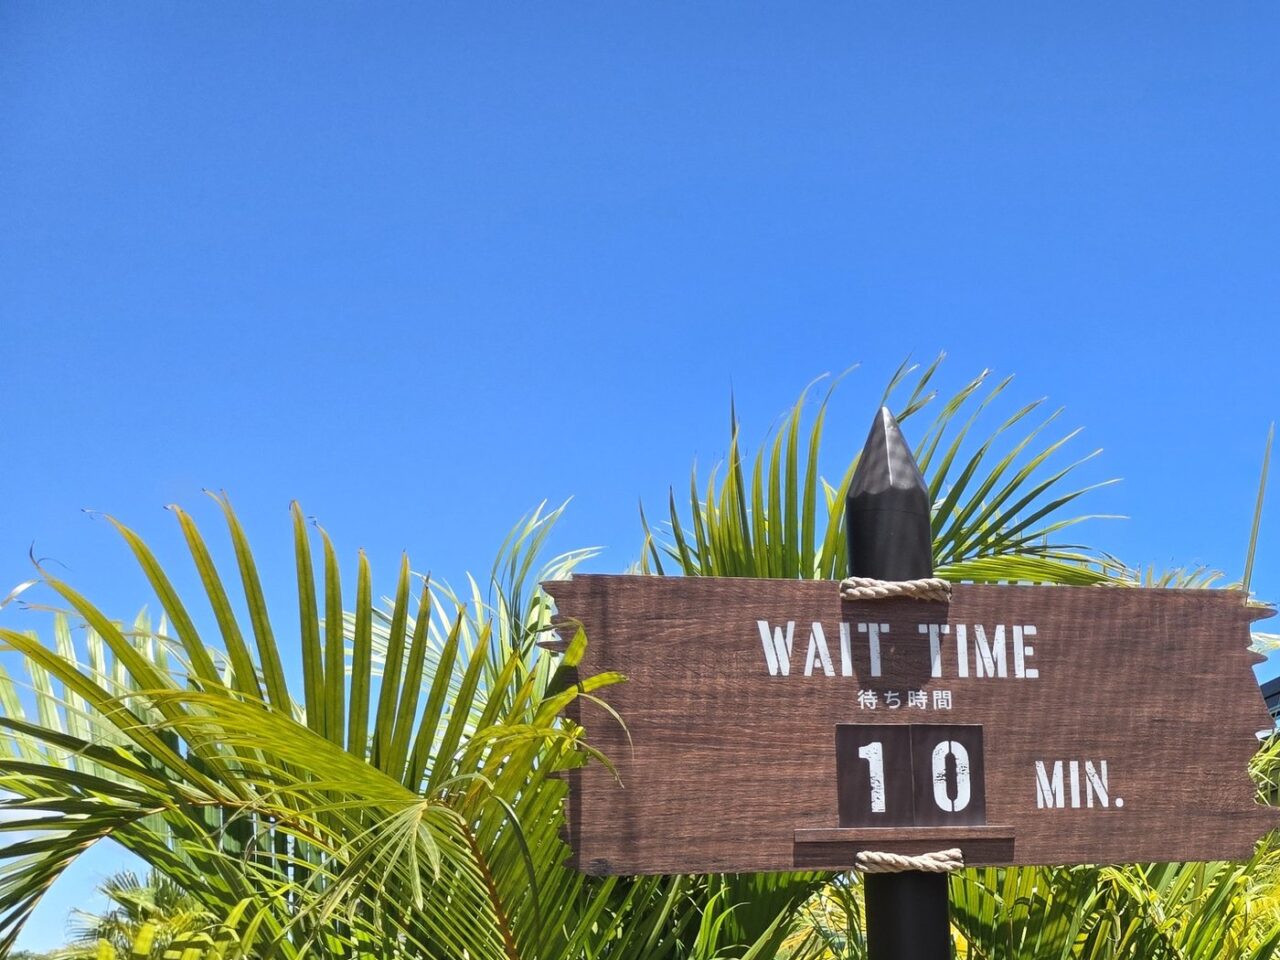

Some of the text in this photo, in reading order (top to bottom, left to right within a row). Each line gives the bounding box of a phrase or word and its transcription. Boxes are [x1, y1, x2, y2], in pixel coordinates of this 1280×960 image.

[758, 620, 1039, 678] WAIT TIME
[857, 689, 953, 711] 待ち時間
[1036, 760, 1124, 808] MIN.
